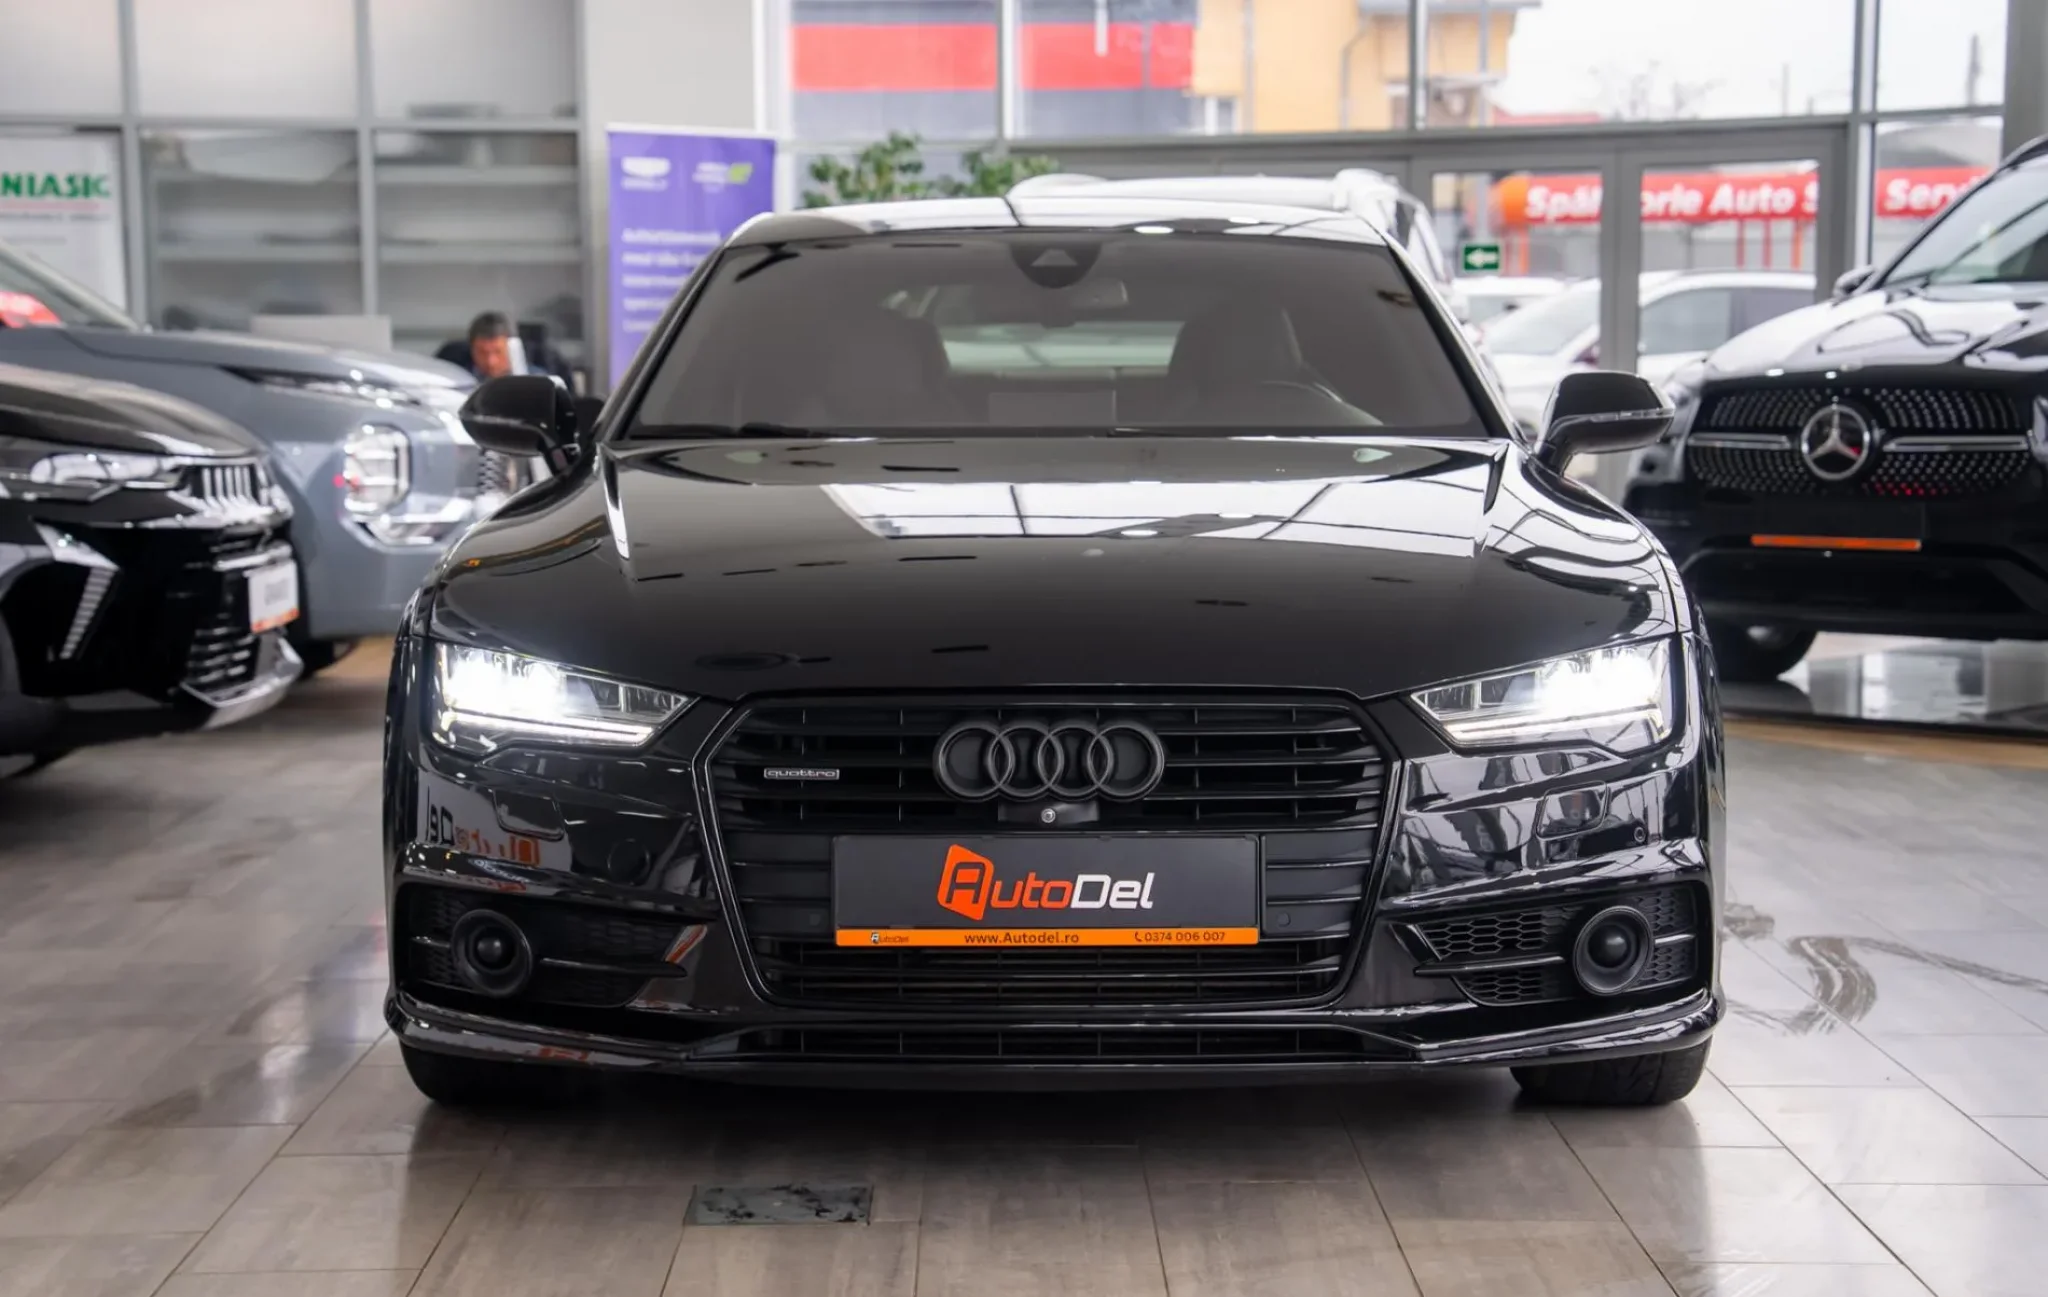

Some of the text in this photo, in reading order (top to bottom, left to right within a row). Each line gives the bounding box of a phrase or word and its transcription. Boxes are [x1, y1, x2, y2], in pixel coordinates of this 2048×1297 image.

[1709, 182, 1797, 217] Auto
[766, 768, 837, 779] quattro
[938, 844, 1155, 921] AutoDel
[964, 931, 1080, 944] www.Autodel.ro
[1144, 930, 1226, 942] 0374 006 007
